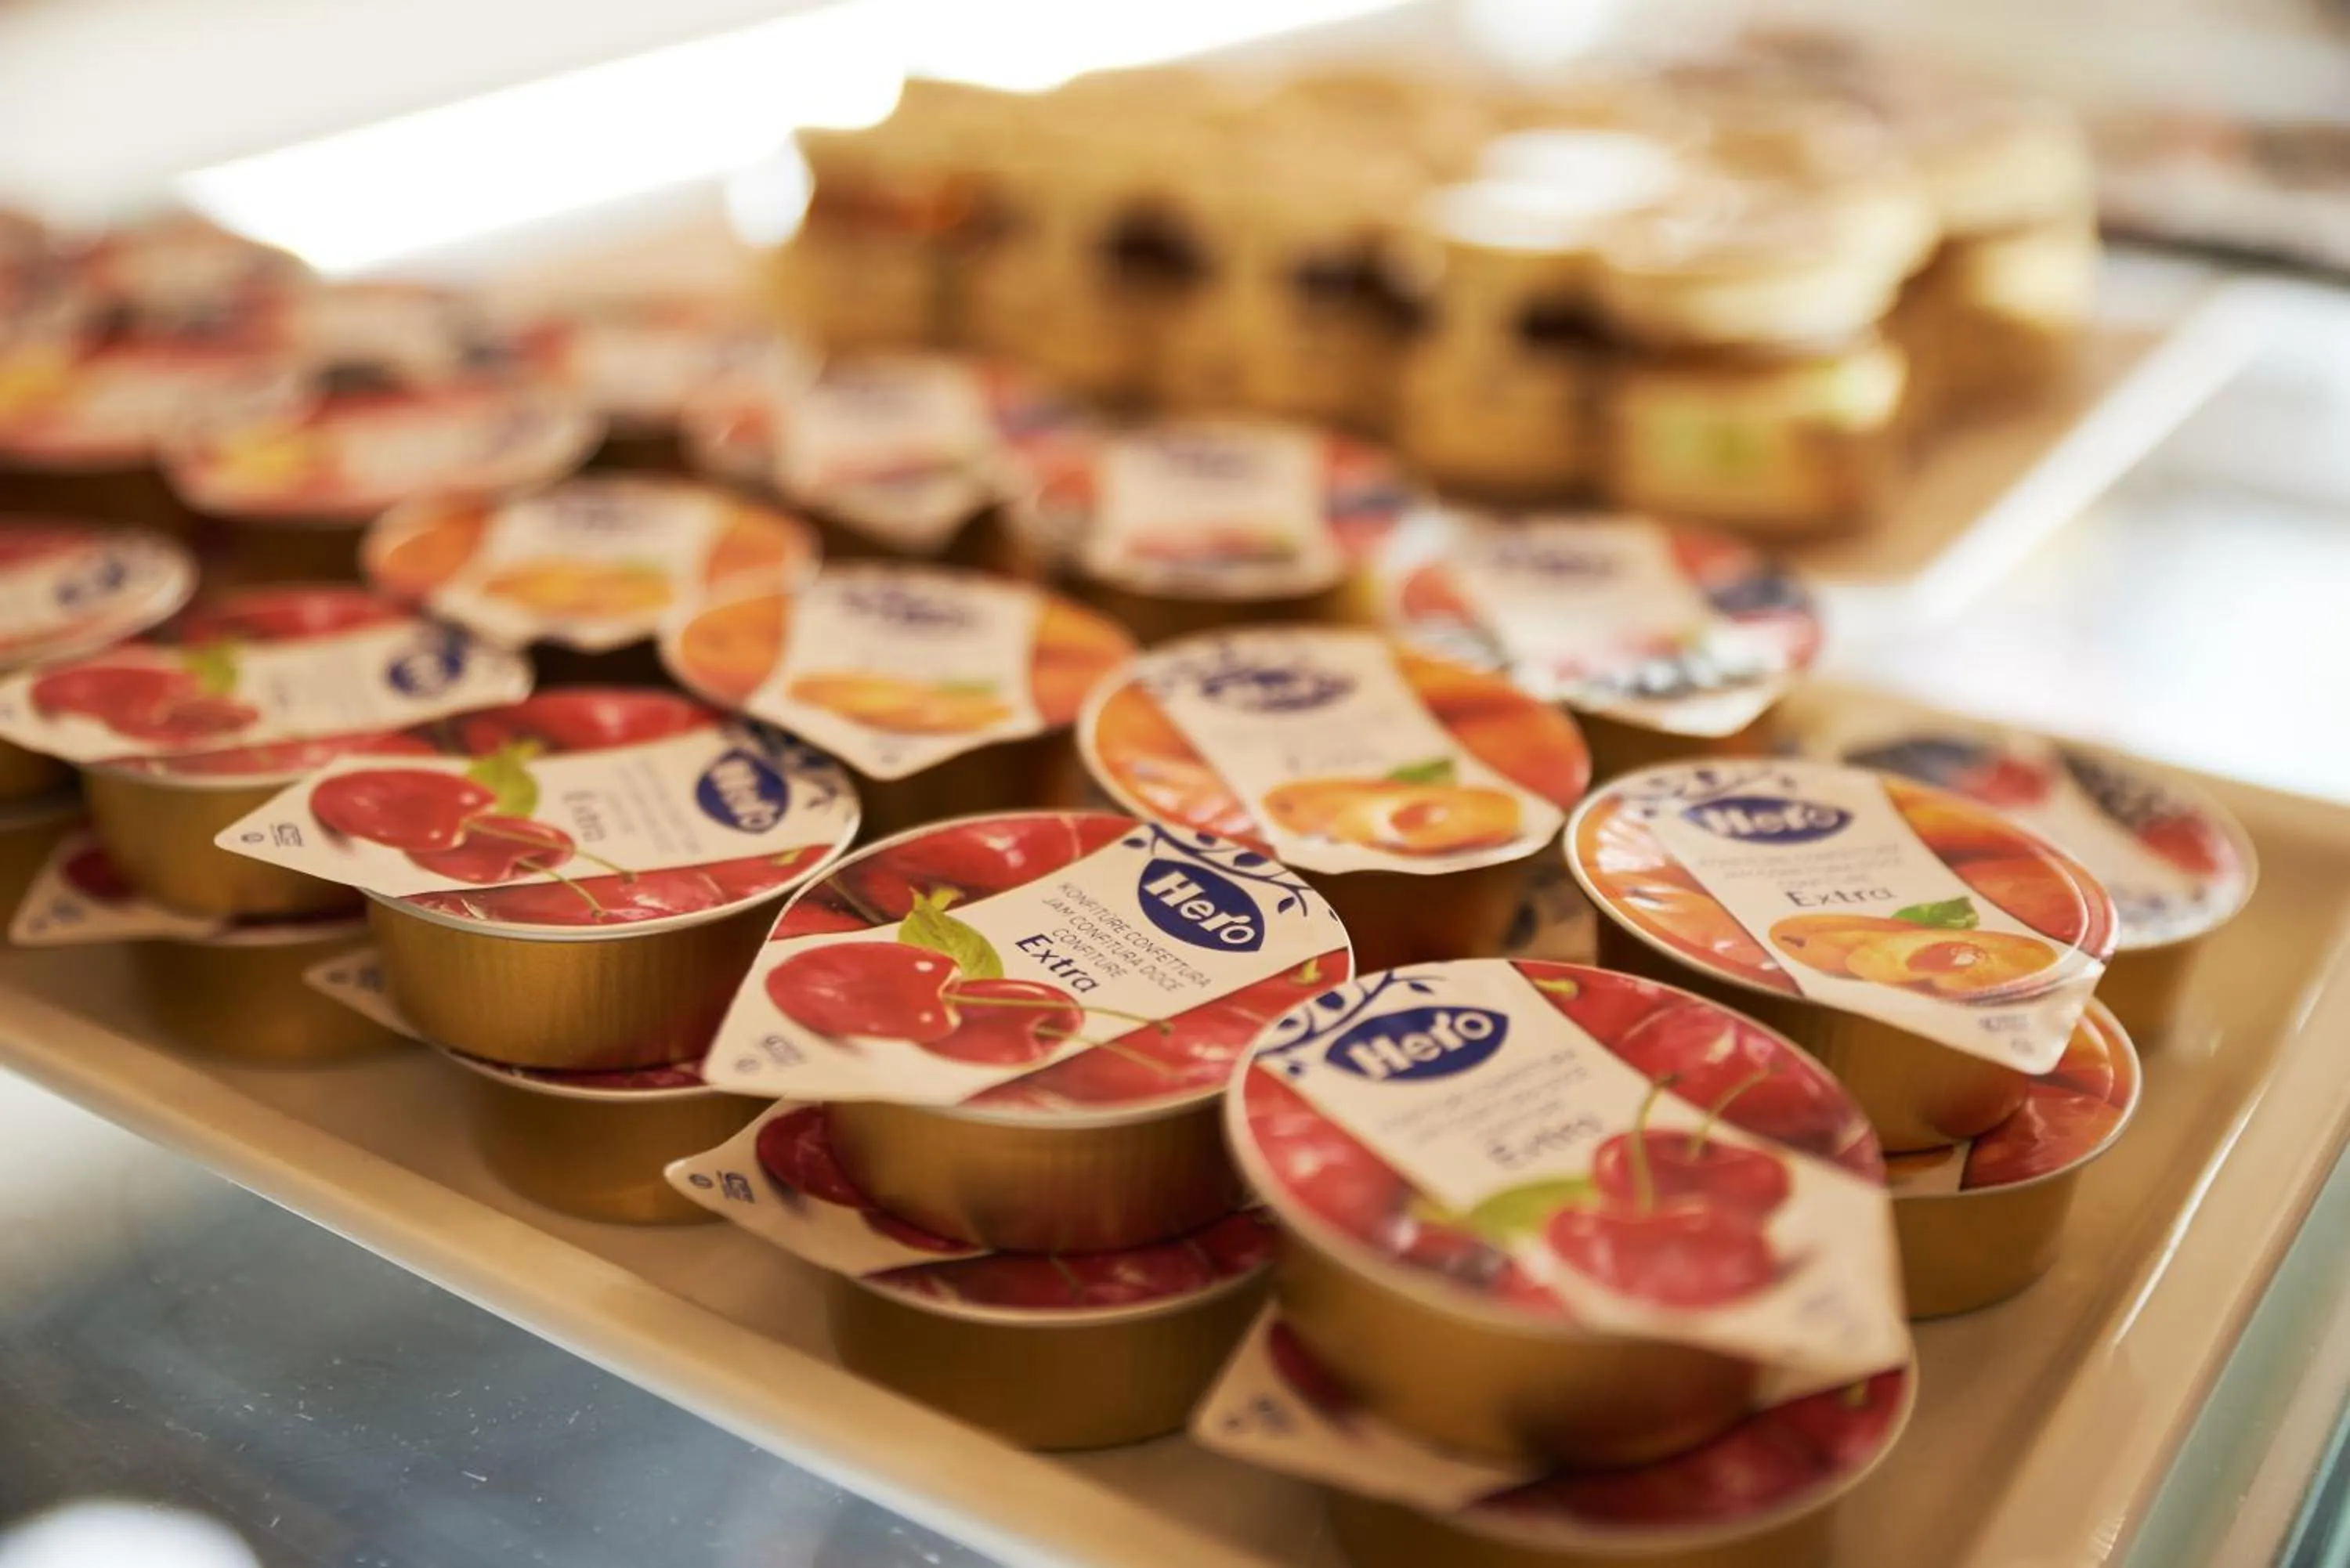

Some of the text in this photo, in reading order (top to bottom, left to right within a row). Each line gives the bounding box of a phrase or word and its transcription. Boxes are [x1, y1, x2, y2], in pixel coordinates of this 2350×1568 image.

[1142, 870, 1255, 945] Hero
[1785, 887, 1896, 908] Extra
[1015, 933, 1099, 993] Extra
[1042, 898, 1073, 917] JAM
[1069, 913, 1138, 967] CONFITURA
[1052, 927, 1129, 980] CONFITURE
[1058, 882, 1212, 988] KONFITURE CONFETTURA
[1347, 1010, 1494, 1079] Hero
